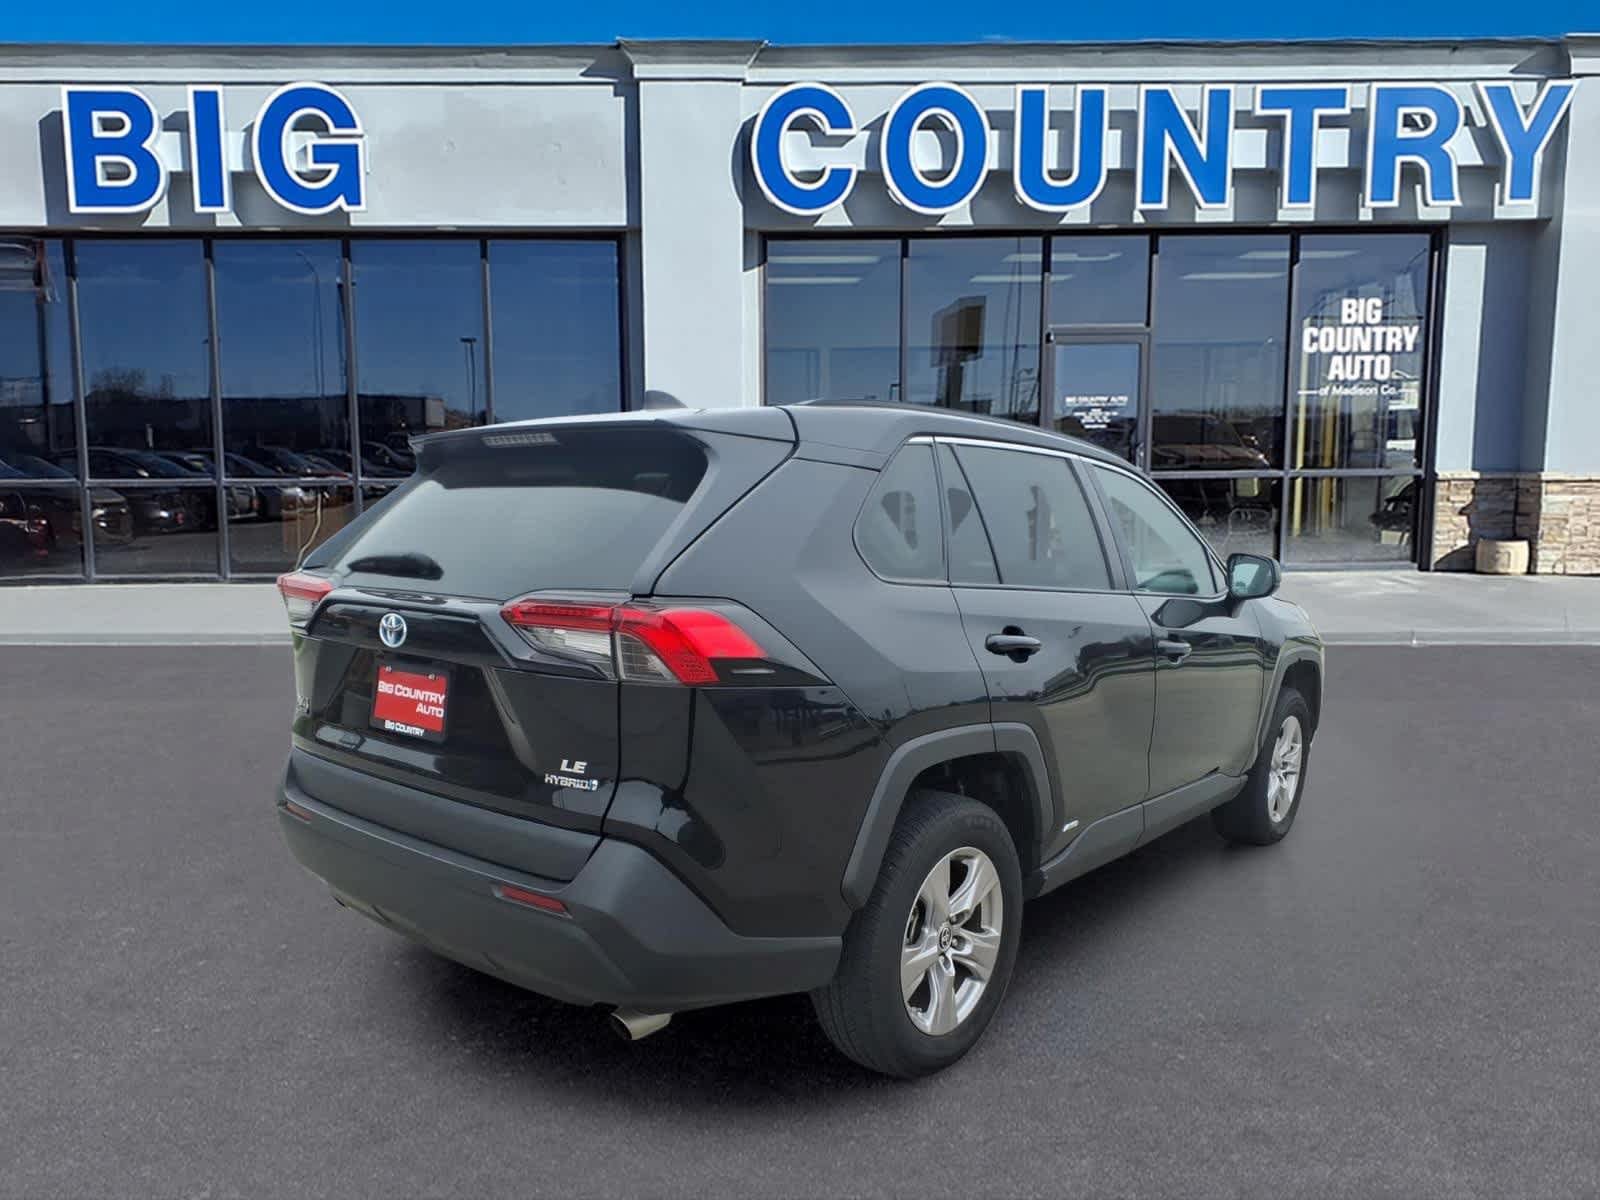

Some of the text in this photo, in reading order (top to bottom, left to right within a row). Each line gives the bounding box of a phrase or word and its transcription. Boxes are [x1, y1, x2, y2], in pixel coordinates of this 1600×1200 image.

[61, 80, 1576, 215] BIG COUNTRY
[1341, 297, 1383, 325] BIG
[1303, 325, 1419, 353] COUNTRY
[1328, 354, 1391, 380] AUTO
[1331, 383, 1378, 396] Madison
[378, 681, 444, 704] BIG COUNTRY
[416, 703, 444, 717] AUTO
[395, 722, 424, 736] COUNTRY
[560, 759, 587, 773] LE
[545, 774, 588, 790] HYBRID
